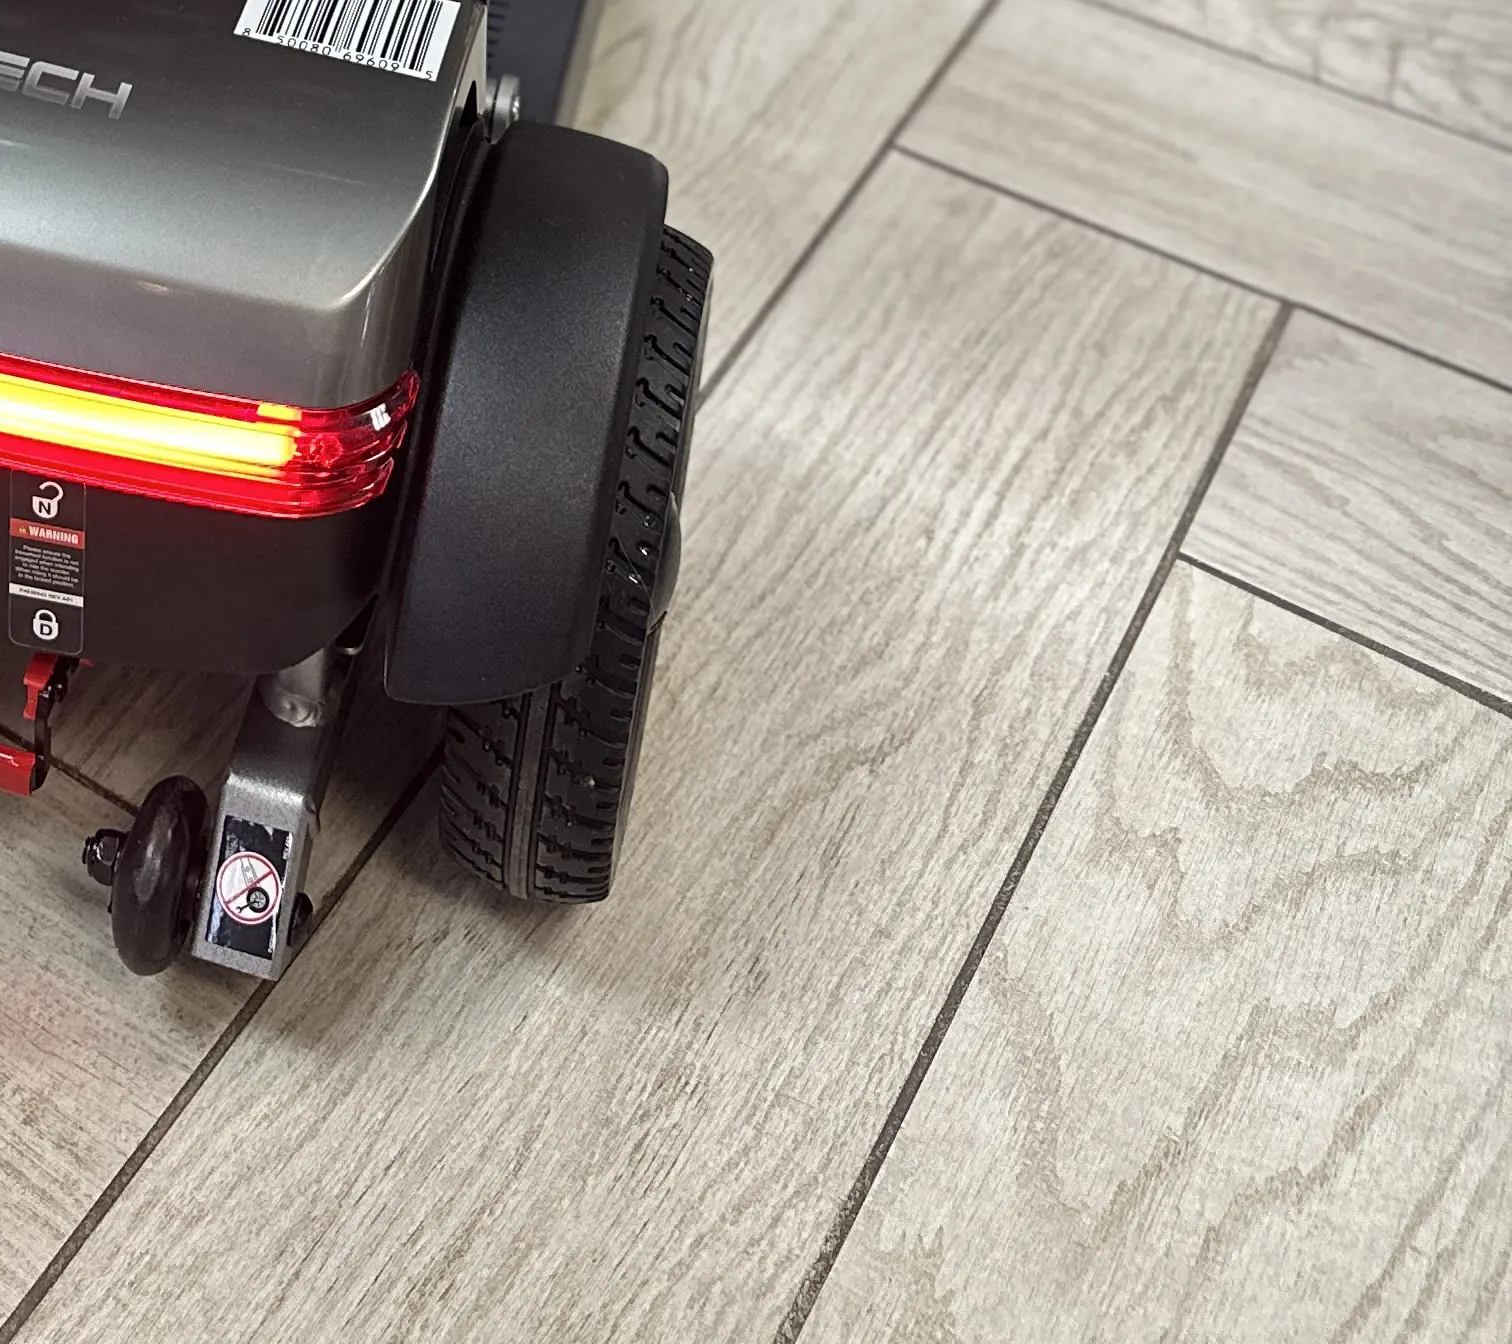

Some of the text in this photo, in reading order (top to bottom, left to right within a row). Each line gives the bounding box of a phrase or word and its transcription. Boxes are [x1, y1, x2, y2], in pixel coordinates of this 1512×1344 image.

[39, 500, 51, 516] N
[29, 525, 79, 545] WARNING
[40, 623, 53, 637] D
